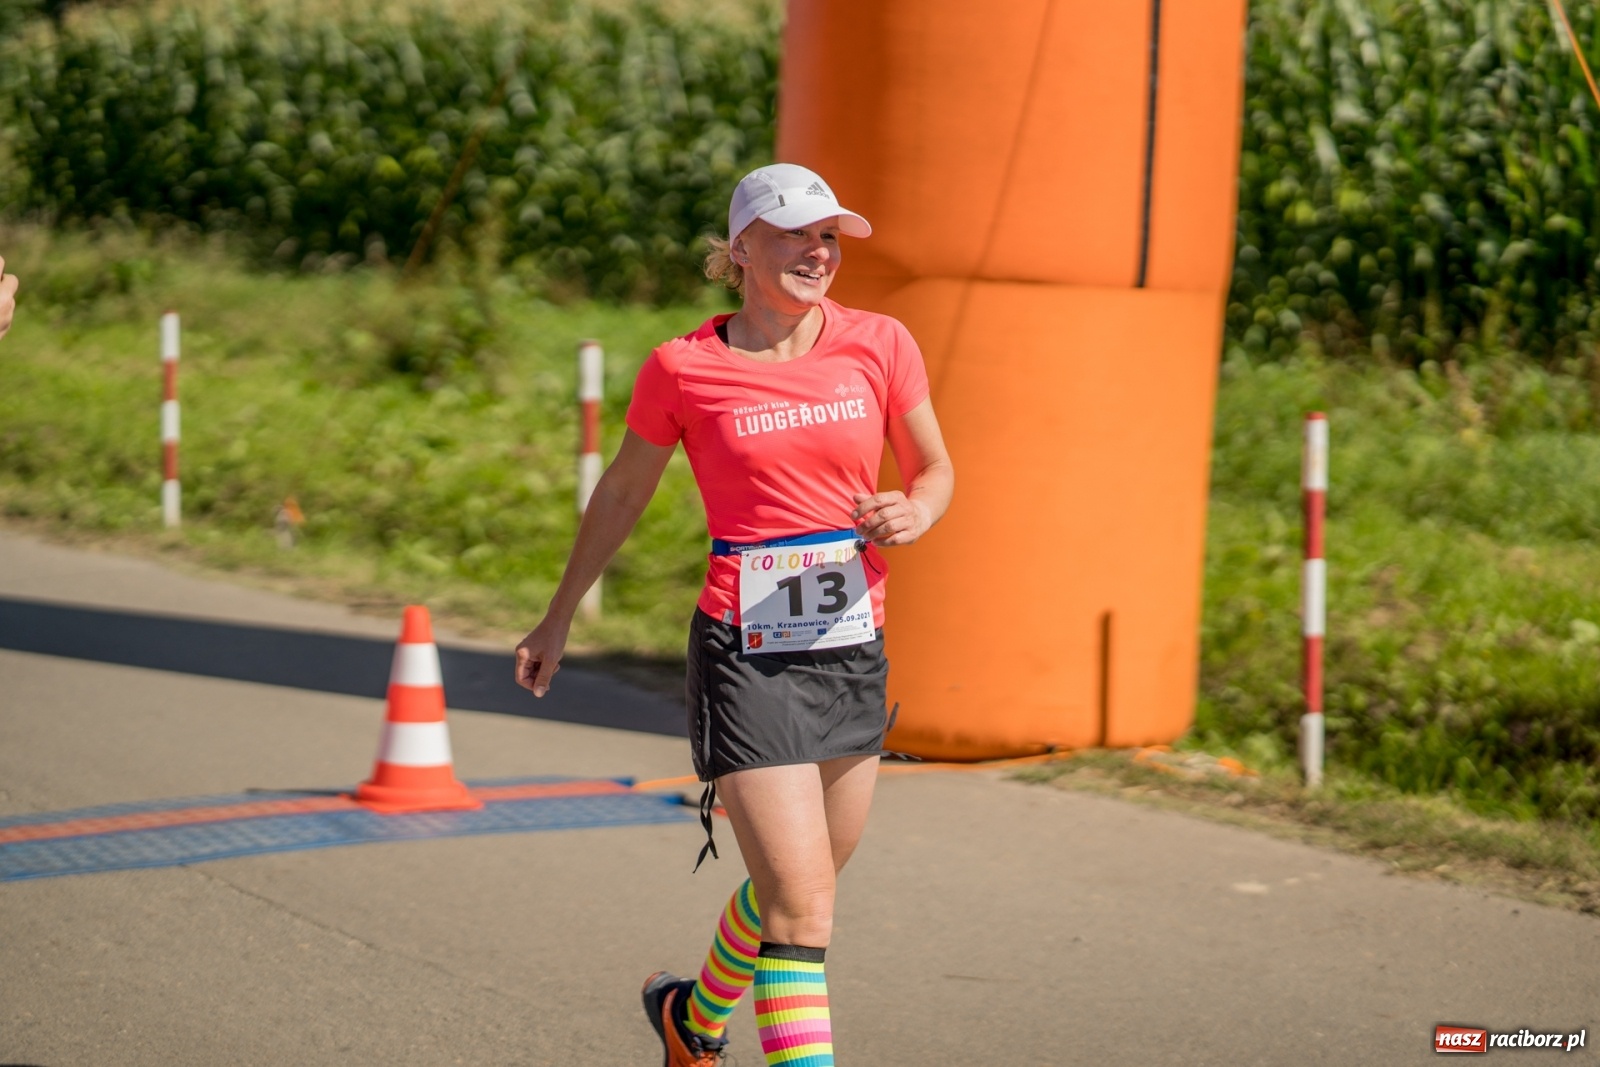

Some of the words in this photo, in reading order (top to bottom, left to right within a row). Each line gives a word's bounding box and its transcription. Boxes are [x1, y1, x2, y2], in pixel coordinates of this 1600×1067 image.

[771, 401, 790, 411] klub
[735, 398, 867, 437] LUDGEŘOVICE
[750, 551, 826, 571] COLOUR
[776, 571, 849, 617] 13
[747, 622, 774, 631] 10km,
[777, 619, 830, 629] Krzanowice,
[834, 611, 871, 624] 05.09.2021
